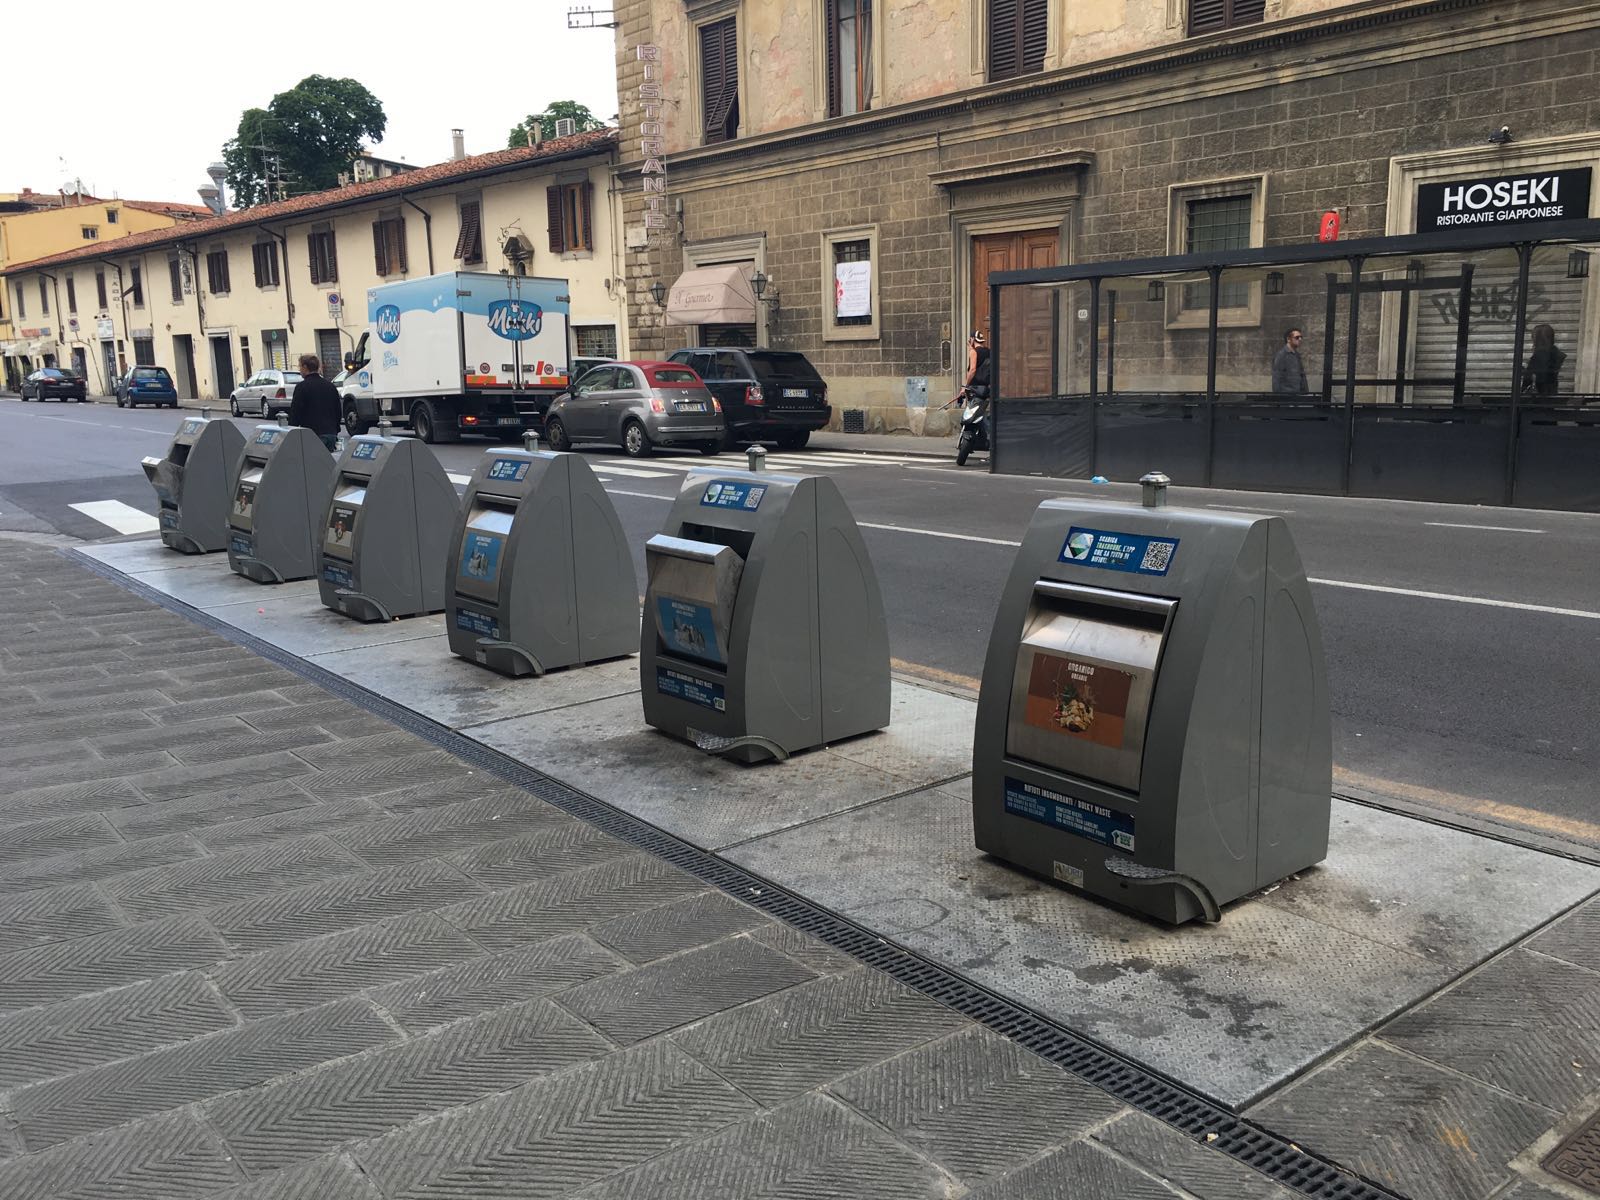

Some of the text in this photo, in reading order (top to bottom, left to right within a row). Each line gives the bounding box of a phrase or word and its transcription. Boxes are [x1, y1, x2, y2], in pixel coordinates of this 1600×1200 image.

[637, 44, 665, 229] RISTORANTE
[1443, 176, 1560, 212] HOSEKI
[1436, 205, 1564, 226] RISTORANTE GIAPPONESE
[376, 311, 400, 339] Mukki
[488, 306, 543, 336] Mukki
[1067, 662, 1095, 676] ORGANICO
[1024, 783, 1040, 795] RIFIUTI
[1041, 788, 1073, 806] INGOMBRANTI
[1078, 800, 1094, 813] BULKY
[1095, 805, 1112, 818] WASTE
